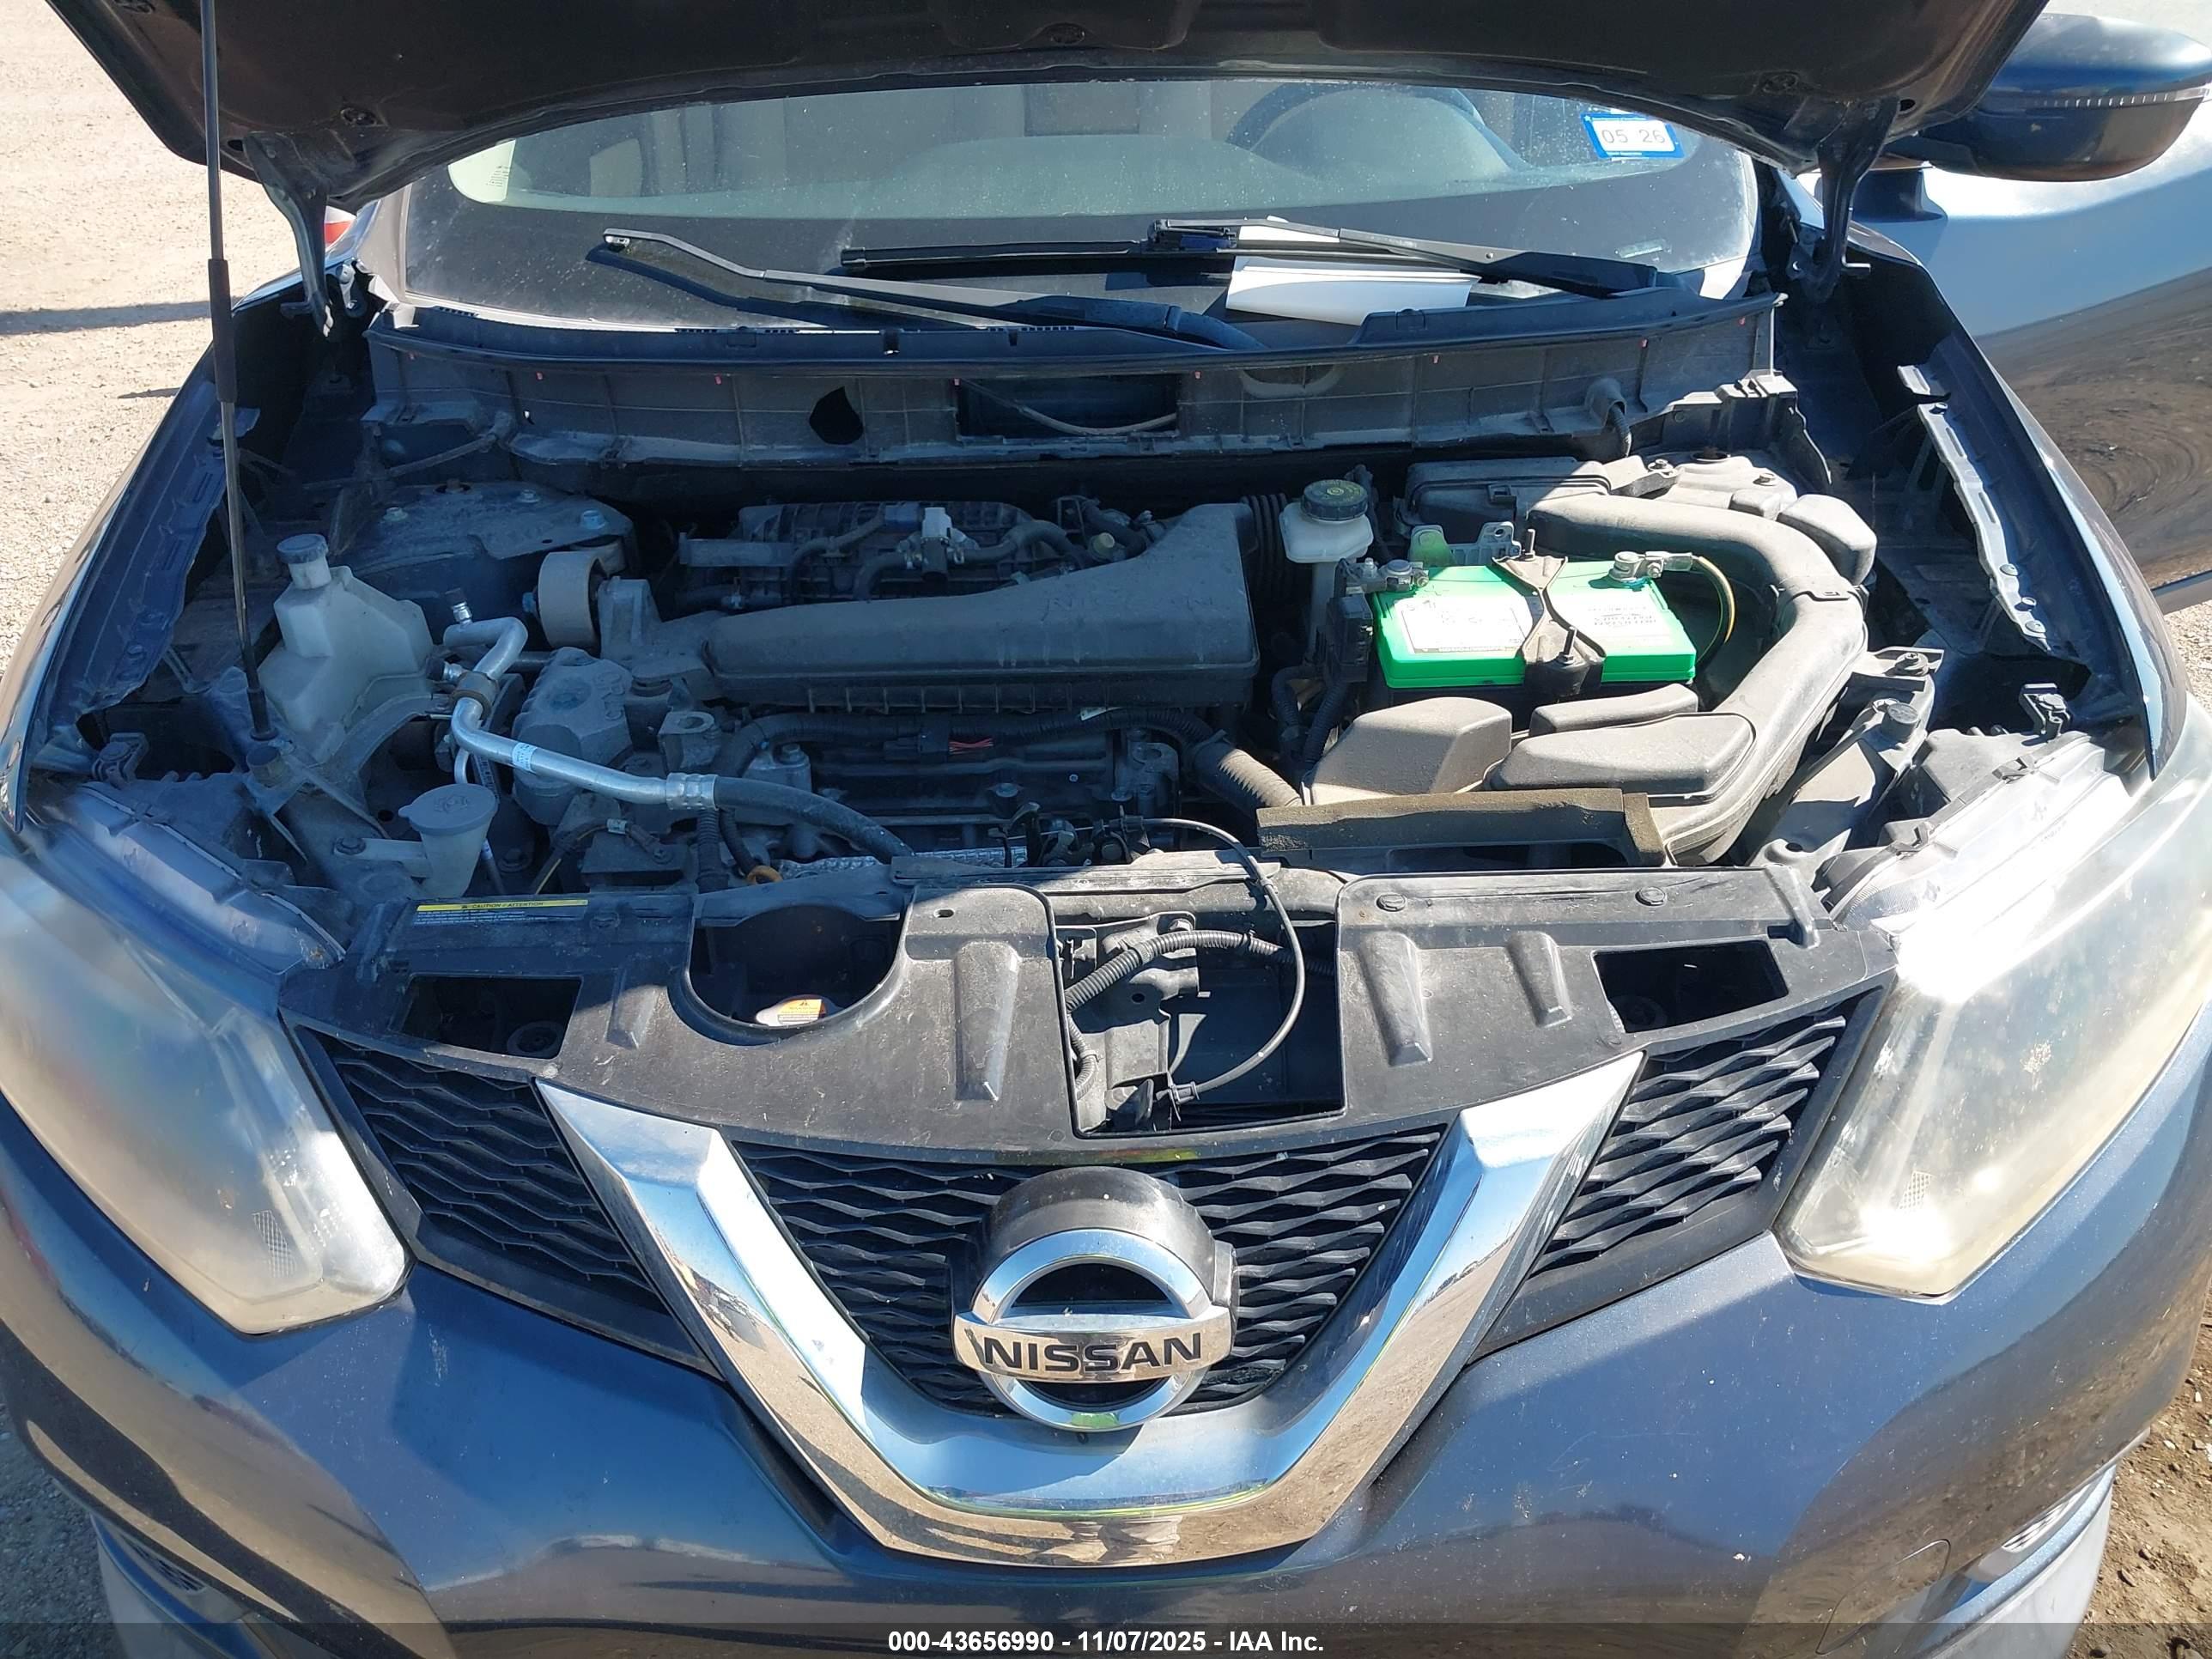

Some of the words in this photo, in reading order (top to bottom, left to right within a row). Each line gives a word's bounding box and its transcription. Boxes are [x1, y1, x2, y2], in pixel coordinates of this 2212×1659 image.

[1602, 129, 1628, 143] 05
[1638, 129, 1666, 143] 26
[982, 1332, 1203, 1372] NISSAN
